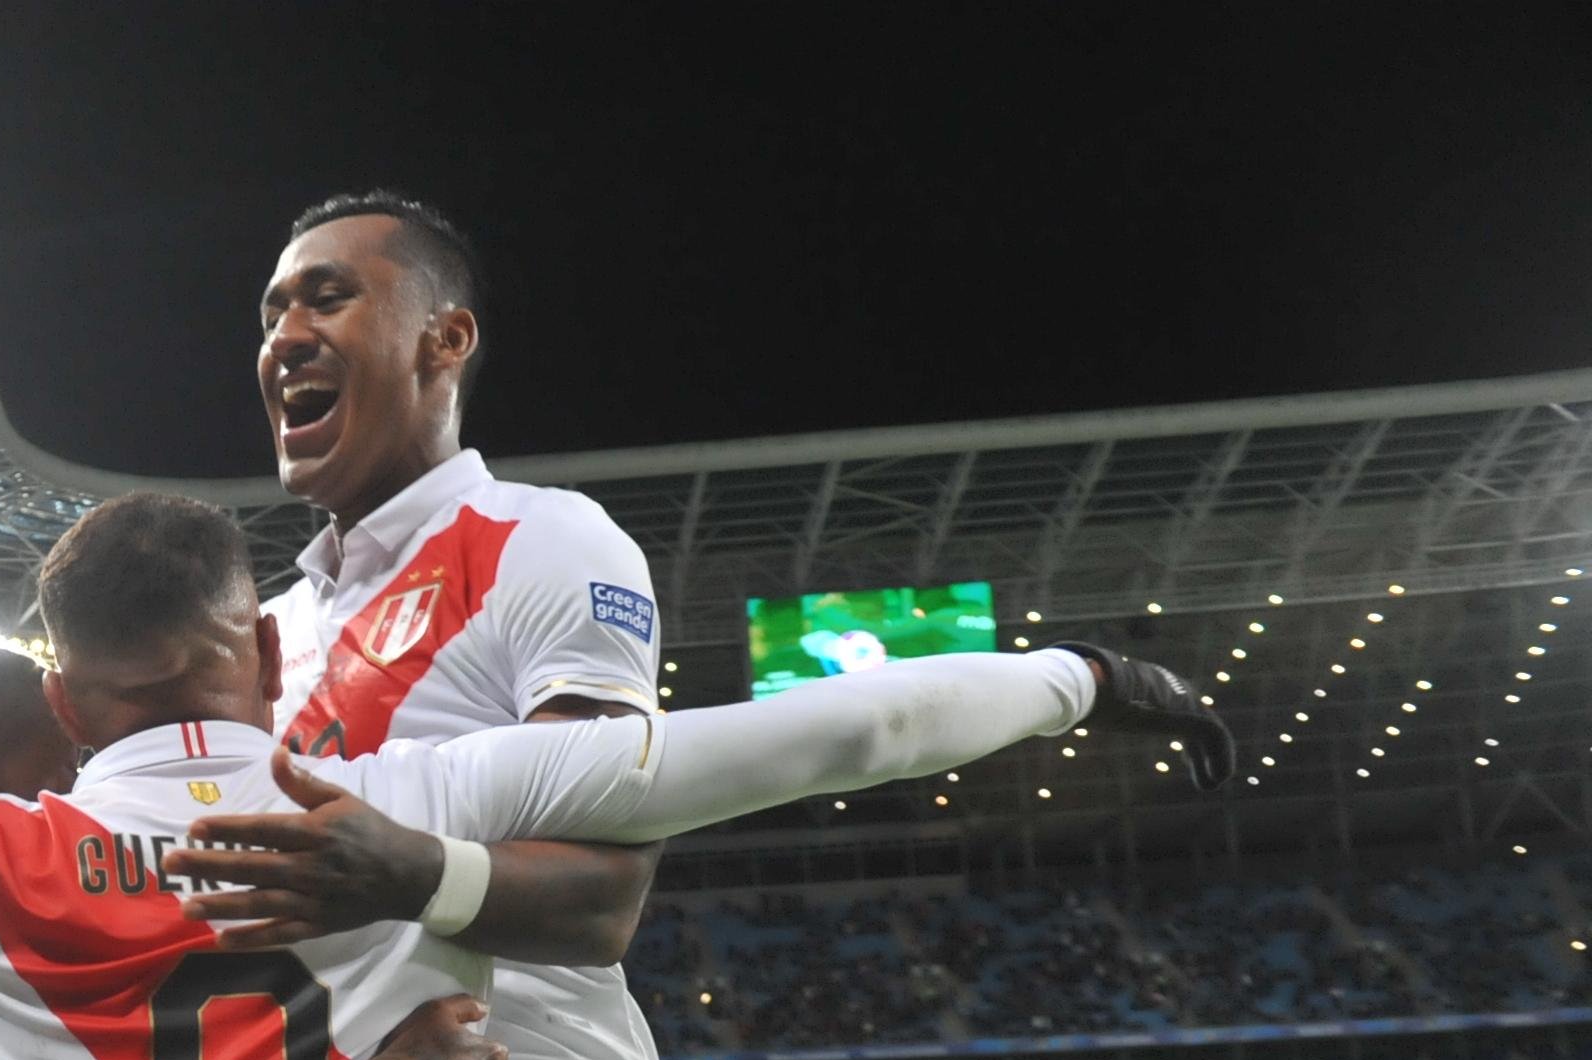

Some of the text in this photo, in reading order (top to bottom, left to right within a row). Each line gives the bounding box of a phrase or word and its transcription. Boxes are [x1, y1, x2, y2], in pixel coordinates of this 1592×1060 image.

[593, 585, 651, 618] Cree en
[595, 603, 648, 634] grande
